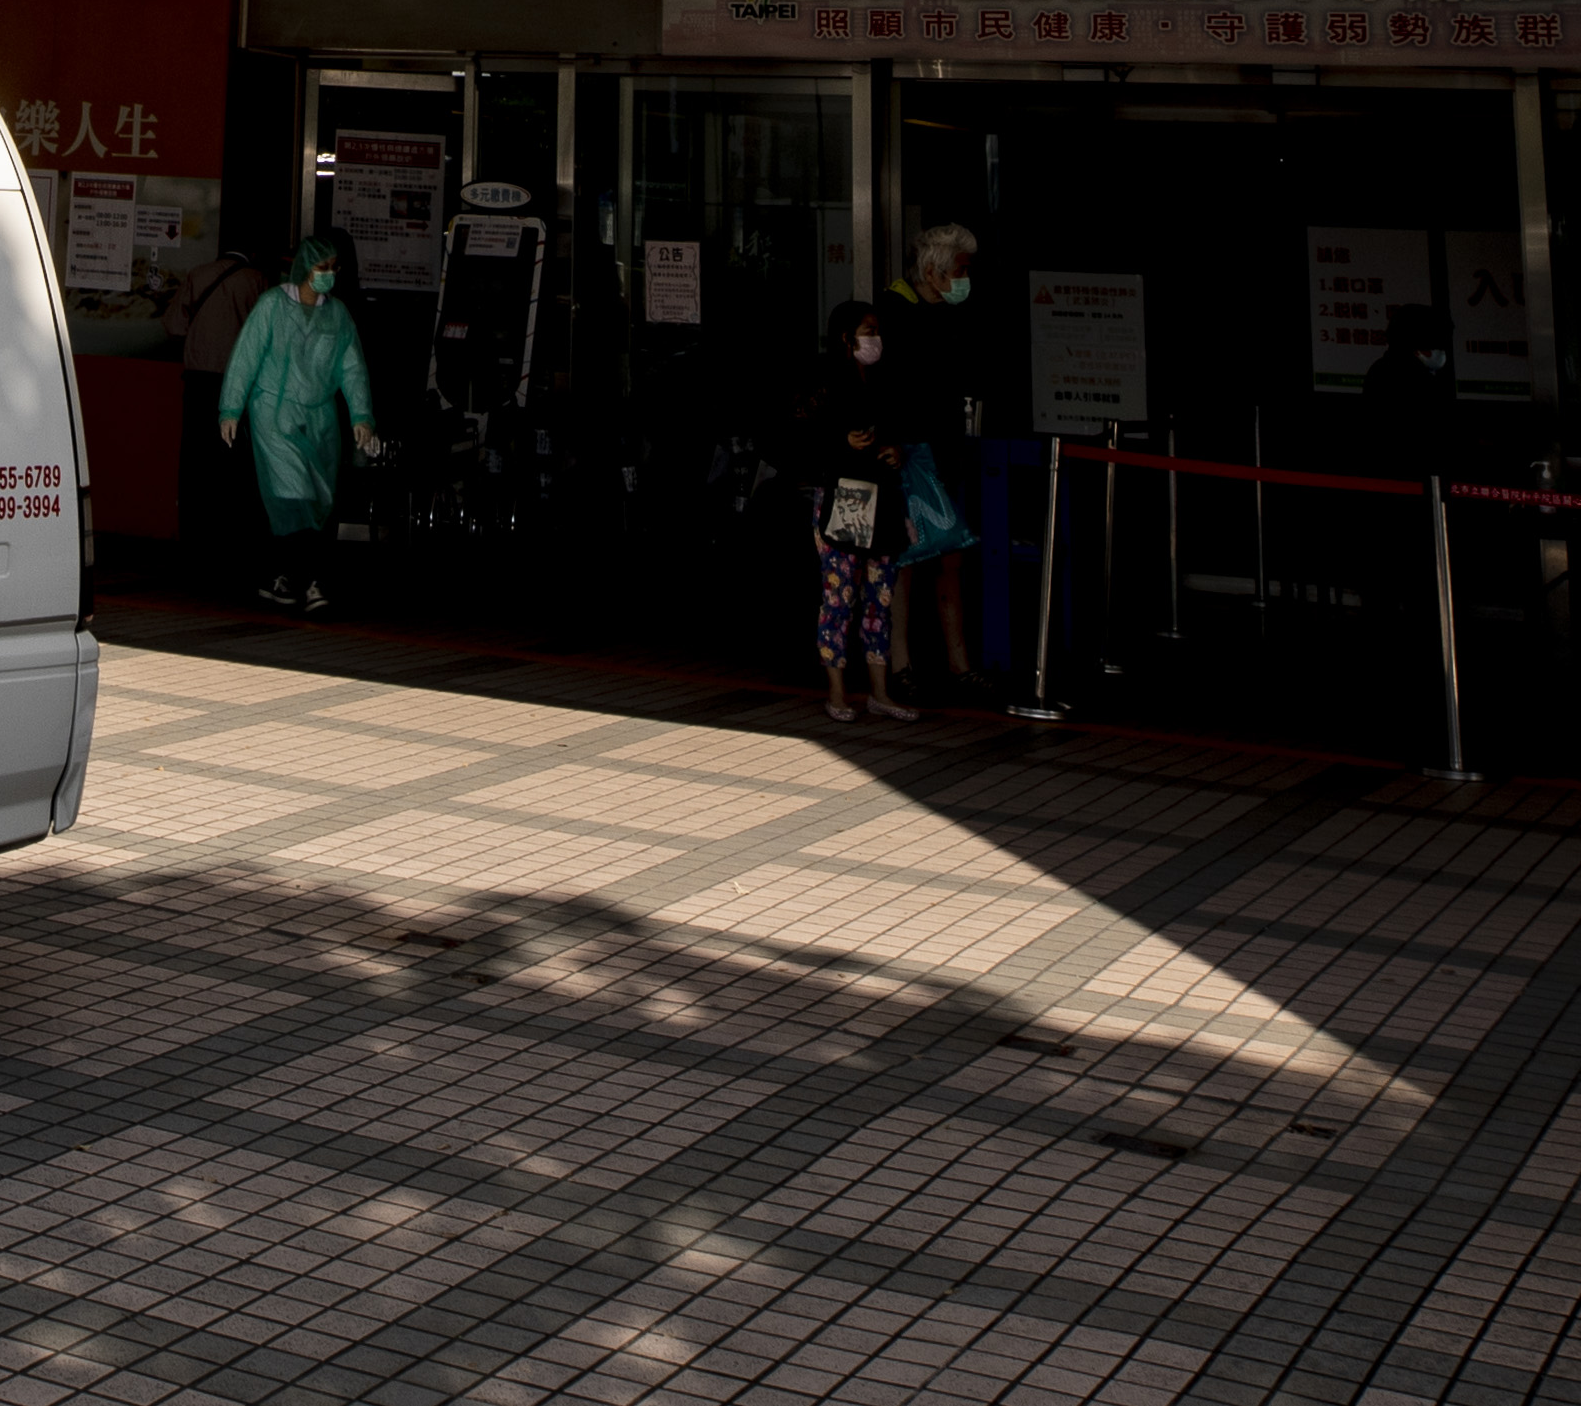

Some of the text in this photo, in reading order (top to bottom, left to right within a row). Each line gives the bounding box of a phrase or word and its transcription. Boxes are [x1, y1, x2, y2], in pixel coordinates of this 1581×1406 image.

[731, 3, 796, 20] TAIPEI
[0, 99, 159, 159] 樂人生
[659, 247, 685, 262] 公告
